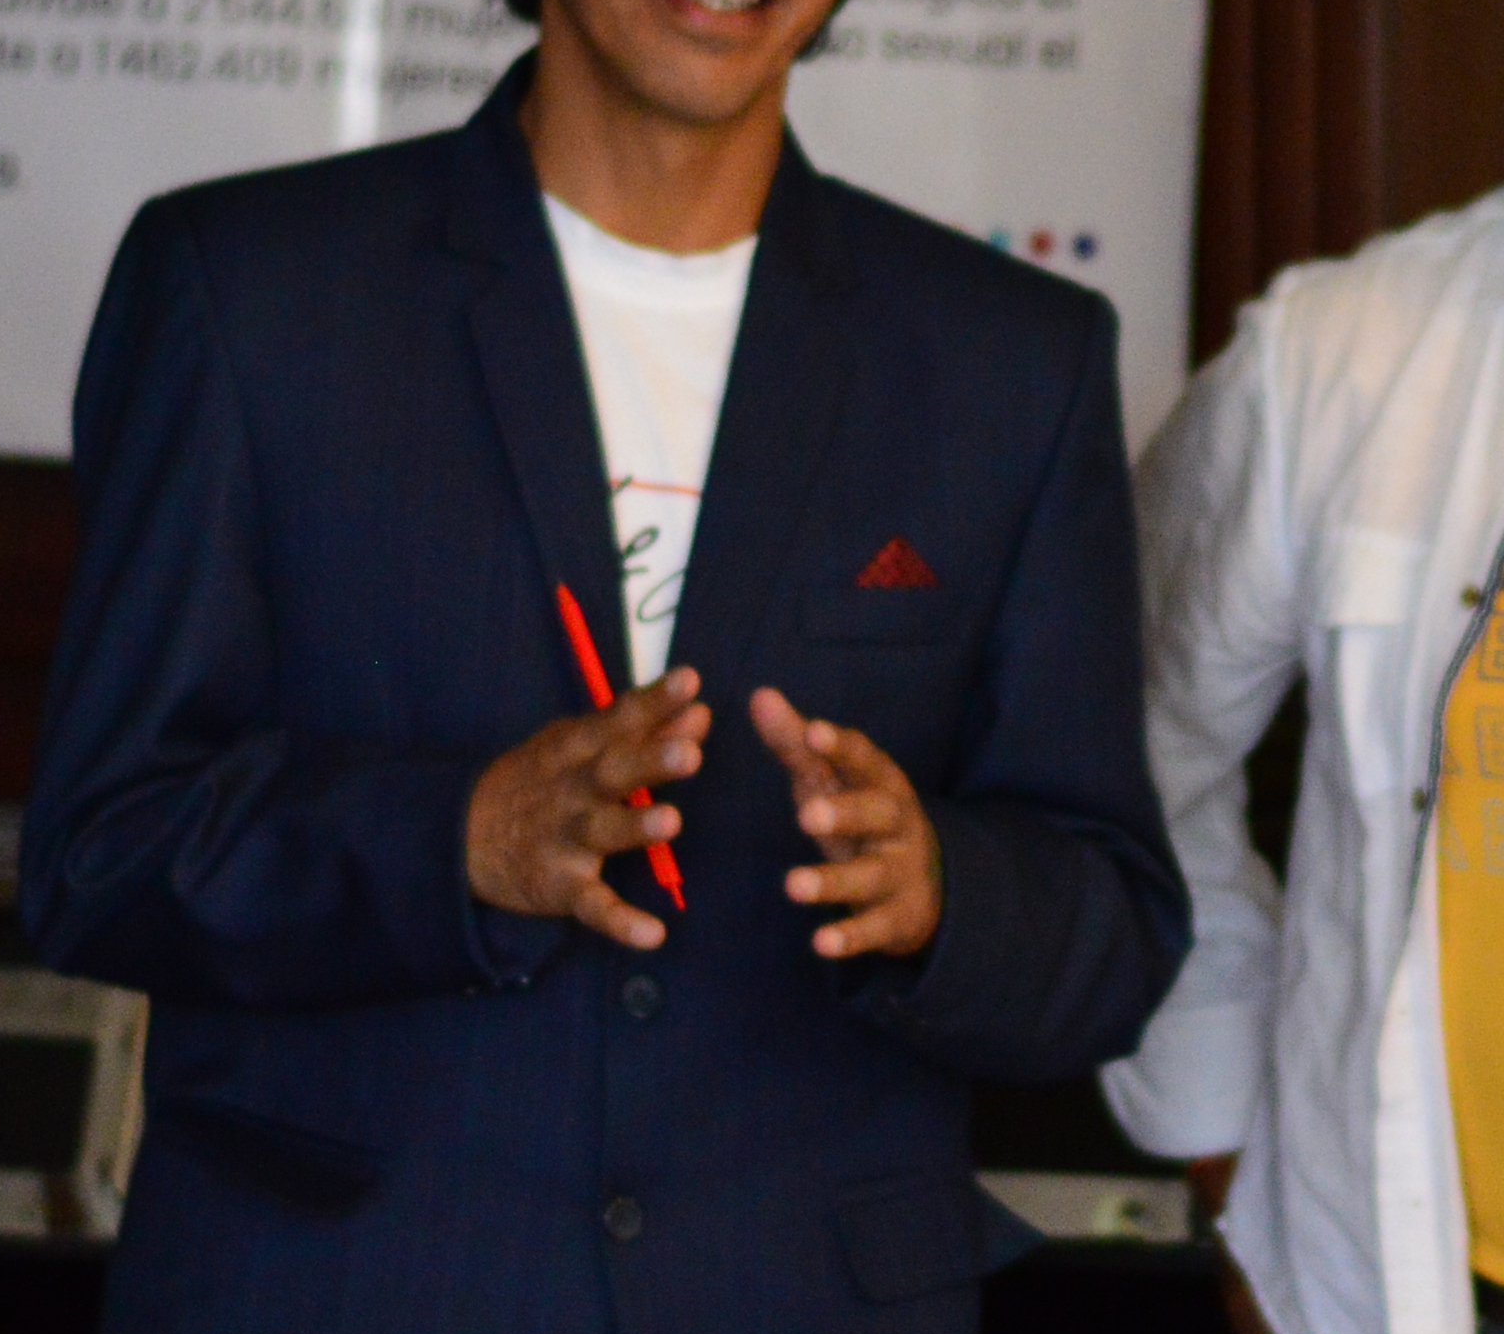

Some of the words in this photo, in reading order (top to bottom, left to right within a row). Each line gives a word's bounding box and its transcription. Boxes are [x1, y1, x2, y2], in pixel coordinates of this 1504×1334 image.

[48, 44, 80, 74] a
[881, 29, 1023, 67] sexual
[1039, 31, 1077, 69] el
